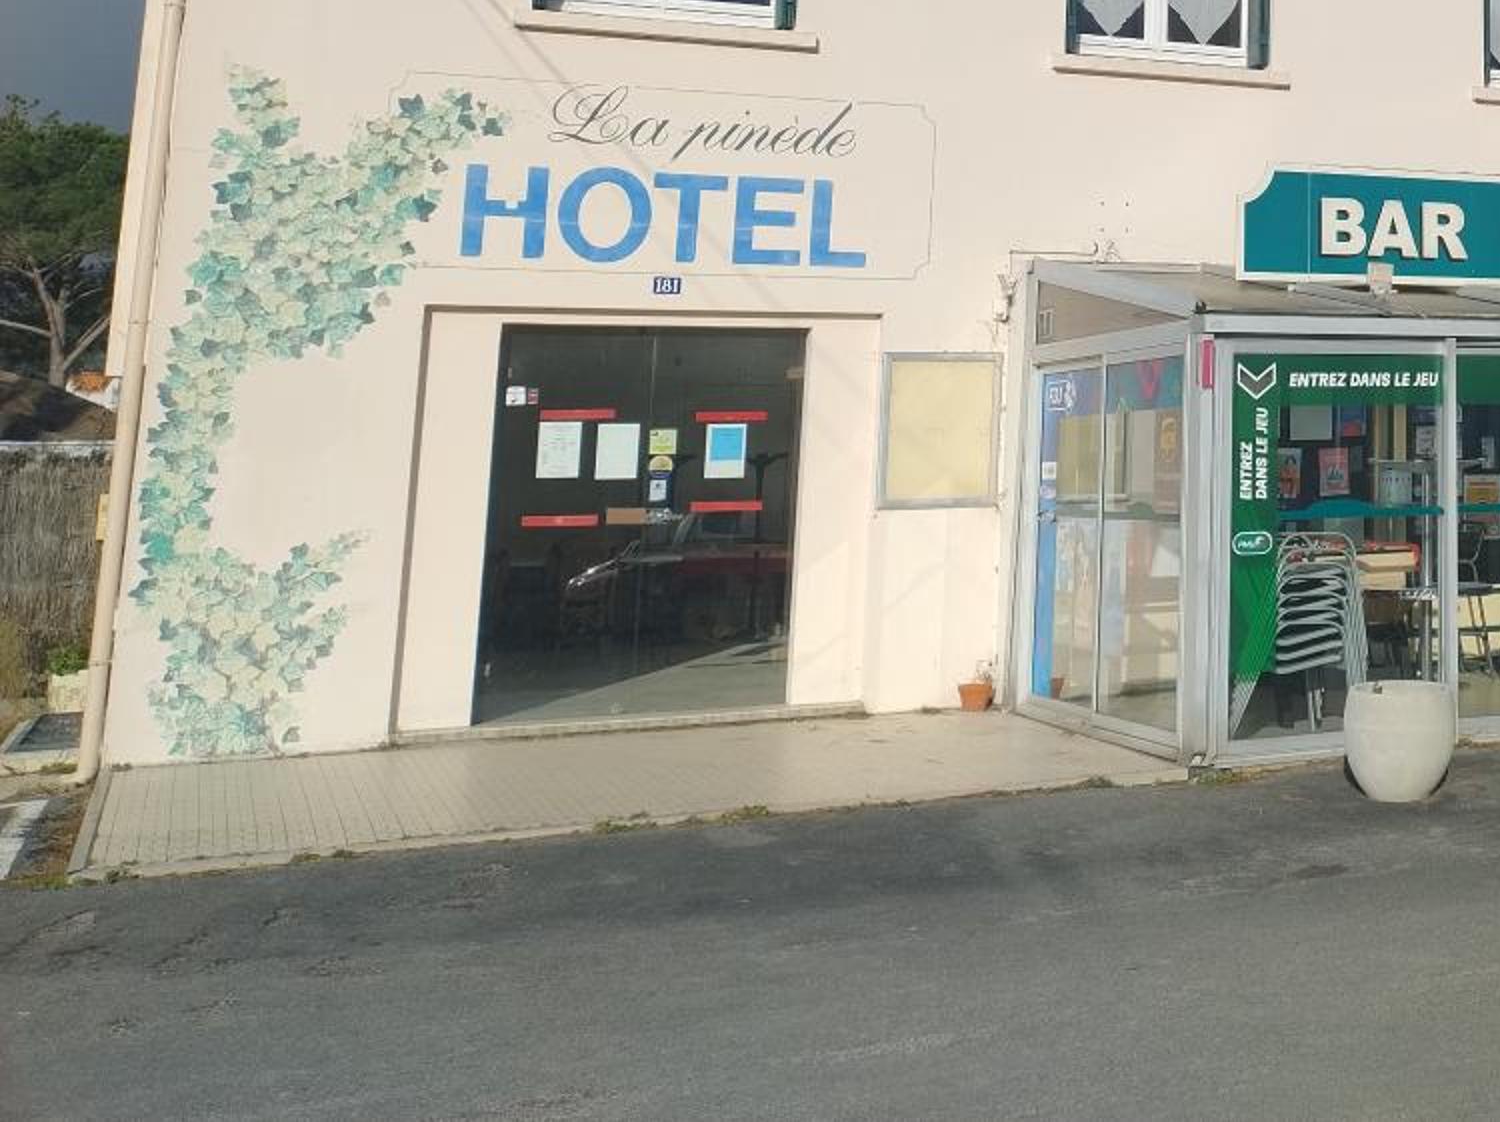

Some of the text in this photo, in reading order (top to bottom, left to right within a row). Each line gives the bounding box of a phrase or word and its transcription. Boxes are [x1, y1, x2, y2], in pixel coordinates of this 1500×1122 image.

[547, 83, 858, 163] La pinède
[459, 163, 868, 269] HOTEL
[1320, 196, 1469, 261] BAR
[655, 278, 679, 293] 181
[1289, 371, 1439, 388] ENTREZ DANS LE JEU
[1239, 441, 1253, 500] ENTREZ
[1255, 407, 1269, 499] DANS LE JEU
